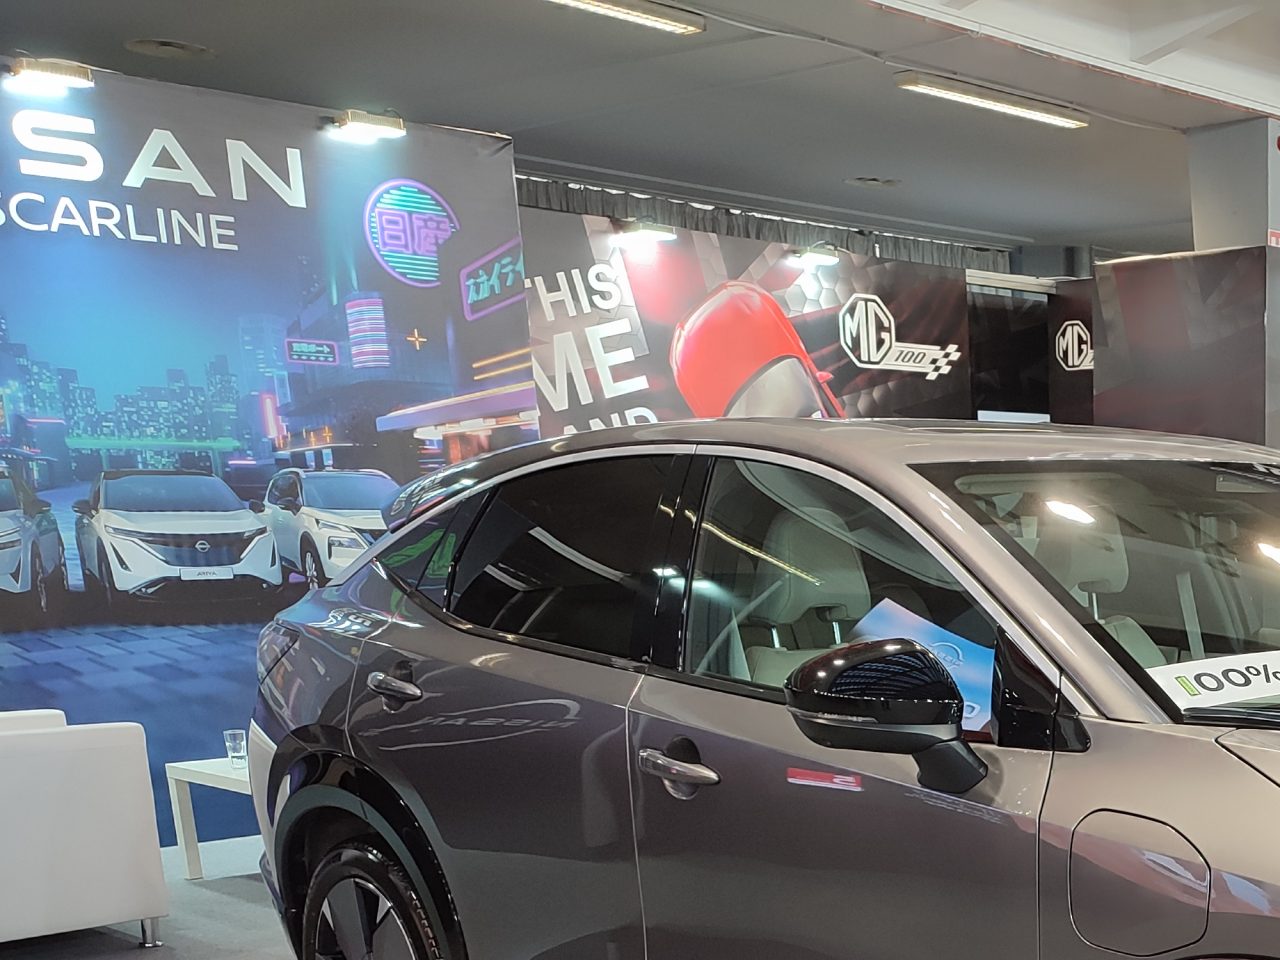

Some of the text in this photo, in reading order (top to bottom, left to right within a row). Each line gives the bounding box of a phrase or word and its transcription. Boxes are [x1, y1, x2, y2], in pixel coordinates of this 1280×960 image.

[0, 190, 238, 250] CARLINE
[524, 263, 622, 321] HIS
[841, 296, 893, 366] MG
[895, 350, 926, 364] 100
[1058, 322, 1089, 369] MG
